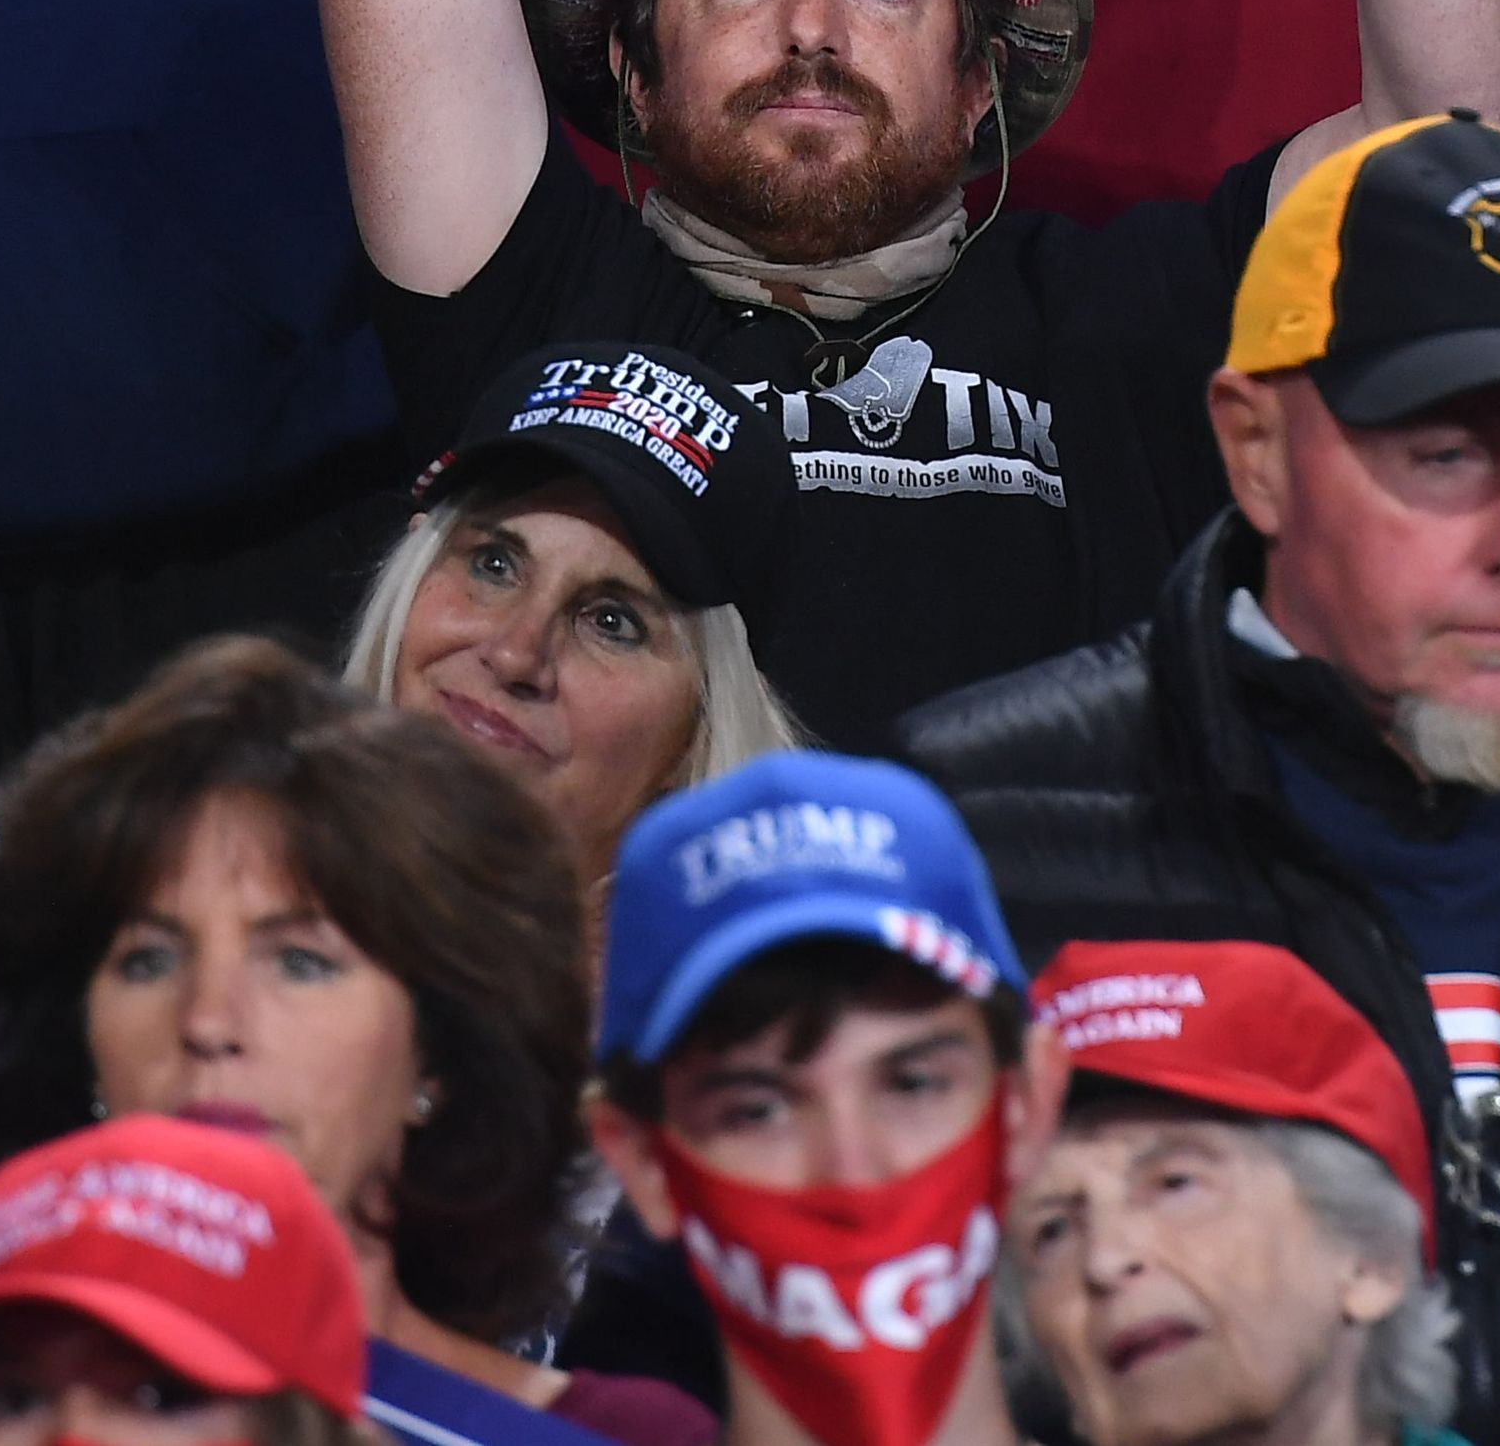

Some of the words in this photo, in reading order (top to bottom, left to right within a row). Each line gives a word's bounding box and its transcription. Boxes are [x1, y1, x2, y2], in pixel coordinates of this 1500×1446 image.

[539, 359, 732, 452] Trump
[607, 391, 683, 441] 2020
[617, 352, 741, 434] President
[509, 407, 560, 433] KEEP
[557, 407, 647, 446] AMERICA
[646, 435, 710, 497] GREAT!
[870, 465, 890, 485] to
[897, 465, 960, 489] those
[969, 463, 1013, 486] who
[1022, 470, 1063, 500] gave
